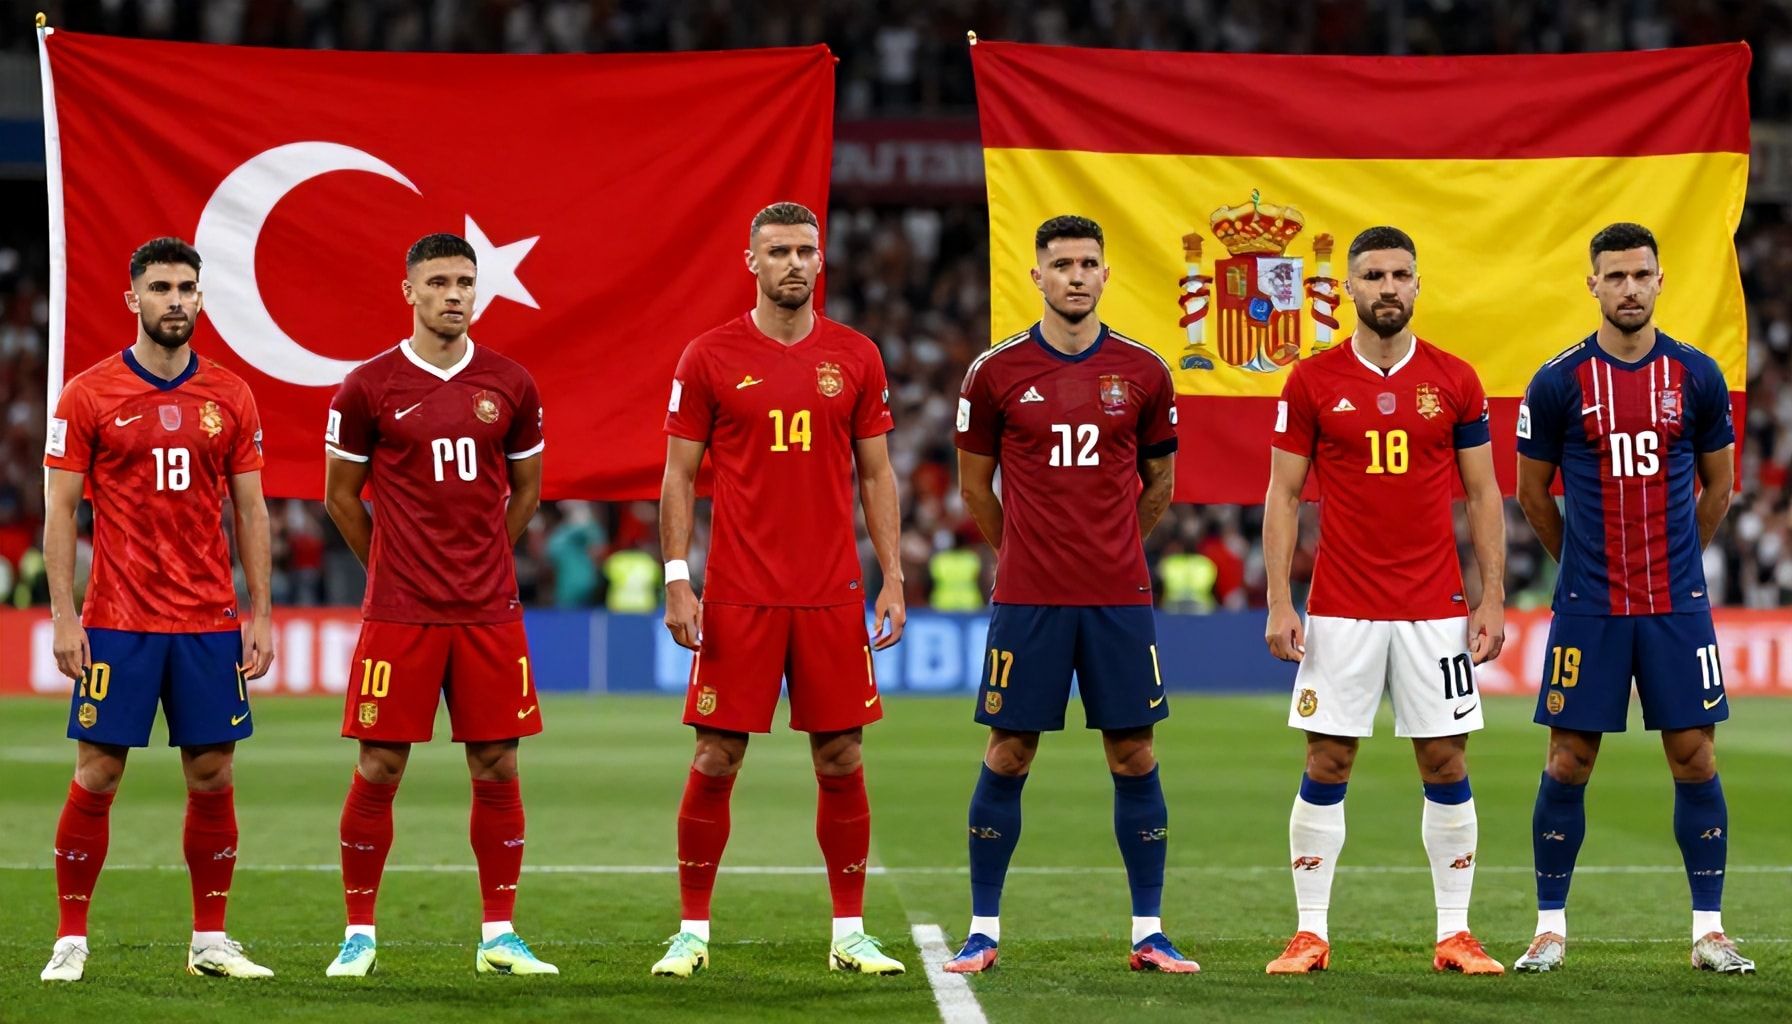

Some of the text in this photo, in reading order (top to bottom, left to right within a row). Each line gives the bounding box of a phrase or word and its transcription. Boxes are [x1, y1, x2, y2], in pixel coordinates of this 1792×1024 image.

[768, 409, 812, 452] 14
[1364, 429, 1409, 475] 18
[360, 657, 392, 698] 10
[989, 648, 1015, 687] 17
[1439, 652, 1476, 699] 10
